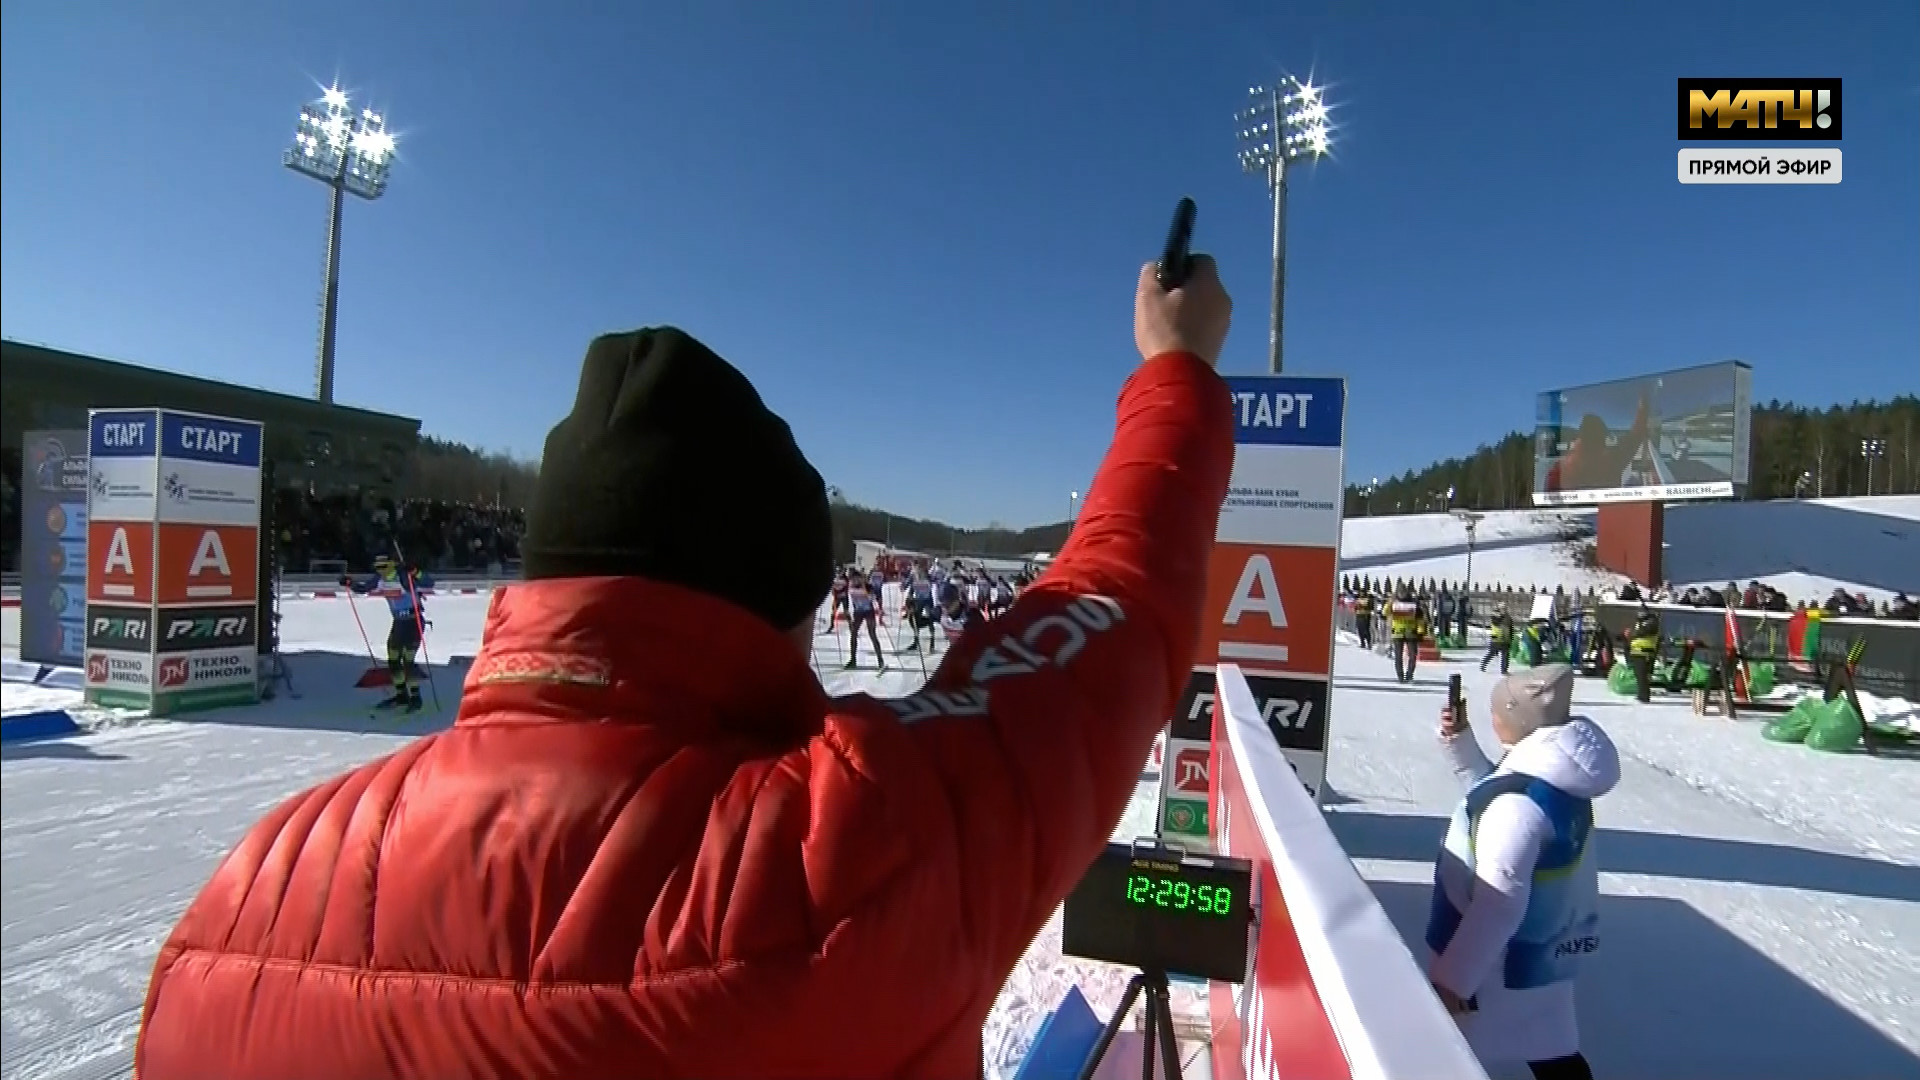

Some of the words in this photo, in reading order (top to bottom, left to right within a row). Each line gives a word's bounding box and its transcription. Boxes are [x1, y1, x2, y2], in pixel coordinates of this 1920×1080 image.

[1231, 391, 1313, 428] ТАРТ
[103, 422, 146, 447] СТАРТ
[181, 426, 242, 455] СТАРТ
[93, 617, 146, 640] PARI
[166, 616, 248, 640] PARI
[111, 658, 142, 671] ТЕХНО
[193, 655, 239, 668] ТЕХНО
[194, 665, 251, 680] НИКОЛЬ
[112, 671, 149, 684] НИКОЛЬ
[1188, 691, 1314, 729] PRI
[1127, 876, 1231, 914] 12:29:58
